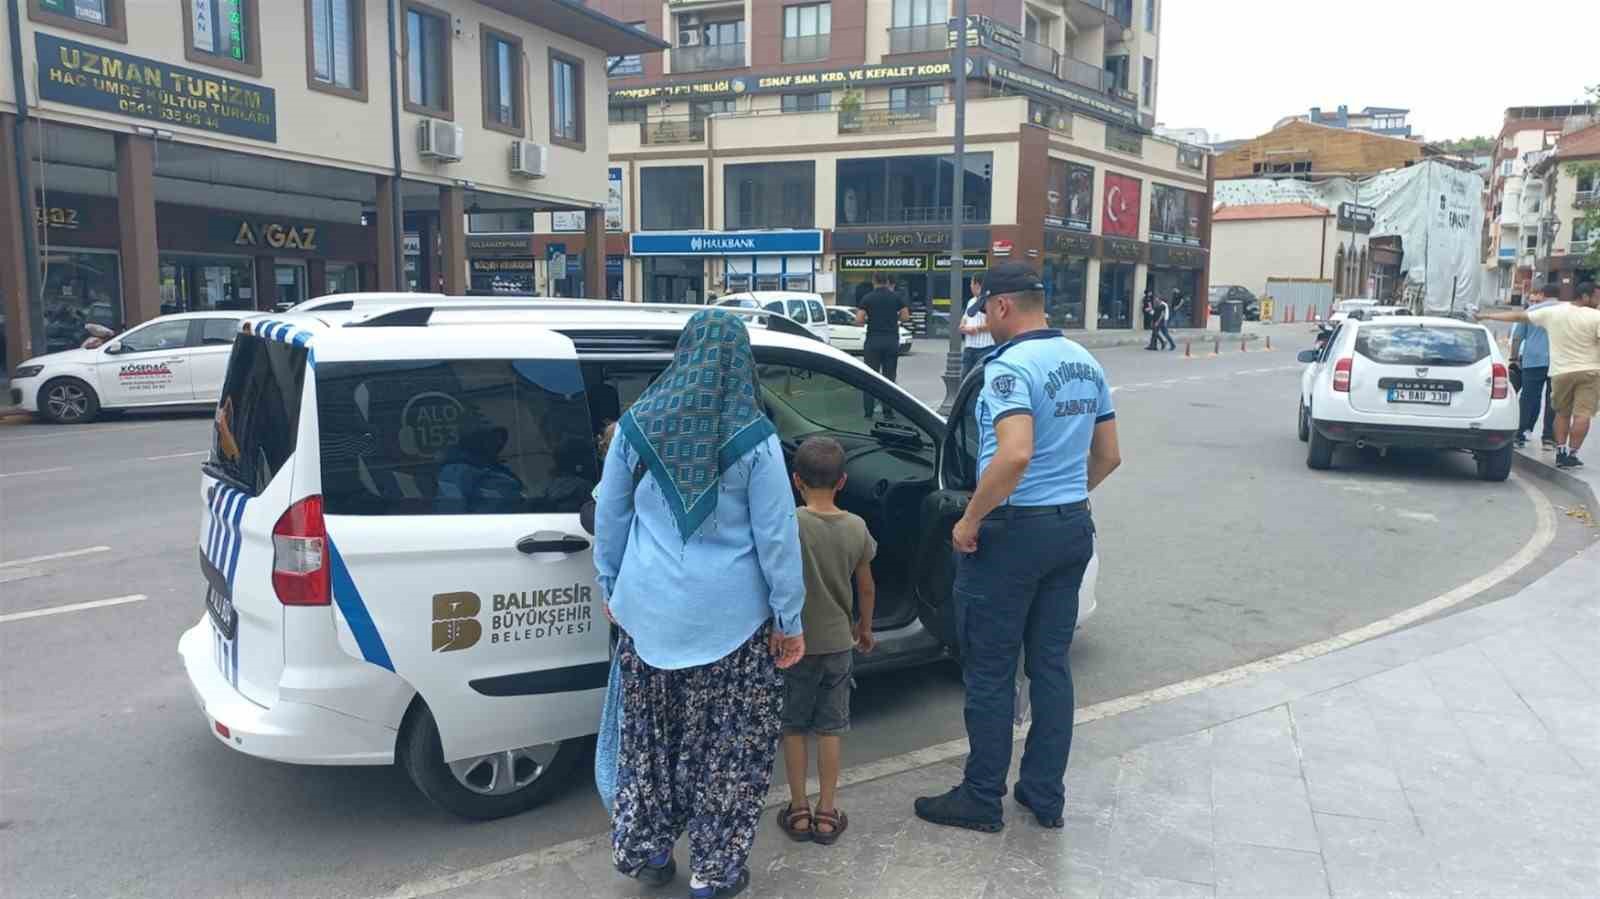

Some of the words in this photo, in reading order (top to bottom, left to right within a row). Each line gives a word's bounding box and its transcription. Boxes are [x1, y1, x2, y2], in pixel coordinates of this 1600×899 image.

[59, 46, 161, 88] UZMAN
[170, 71, 262, 110] TURİZM
[759, 75, 791, 88] ESNAF
[821, 71, 847, 82] KRD.
[849, 69, 864, 80] VE
[866, 66, 914, 80] KEFALET
[703, 237, 755, 249] HALKBANK
[845, 257, 872, 267] KUZU
[875, 257, 922, 268] KOKOREÇ
[963, 258, 985, 267] TAVA
[417, 405, 458, 422] ALO
[417, 425, 459, 447] 153
[492, 583, 592, 612] BALIKESİR
[492, 604, 592, 630] BÜYÜKŞEHİR
[491, 621, 592, 644] BELEDİYESİ
